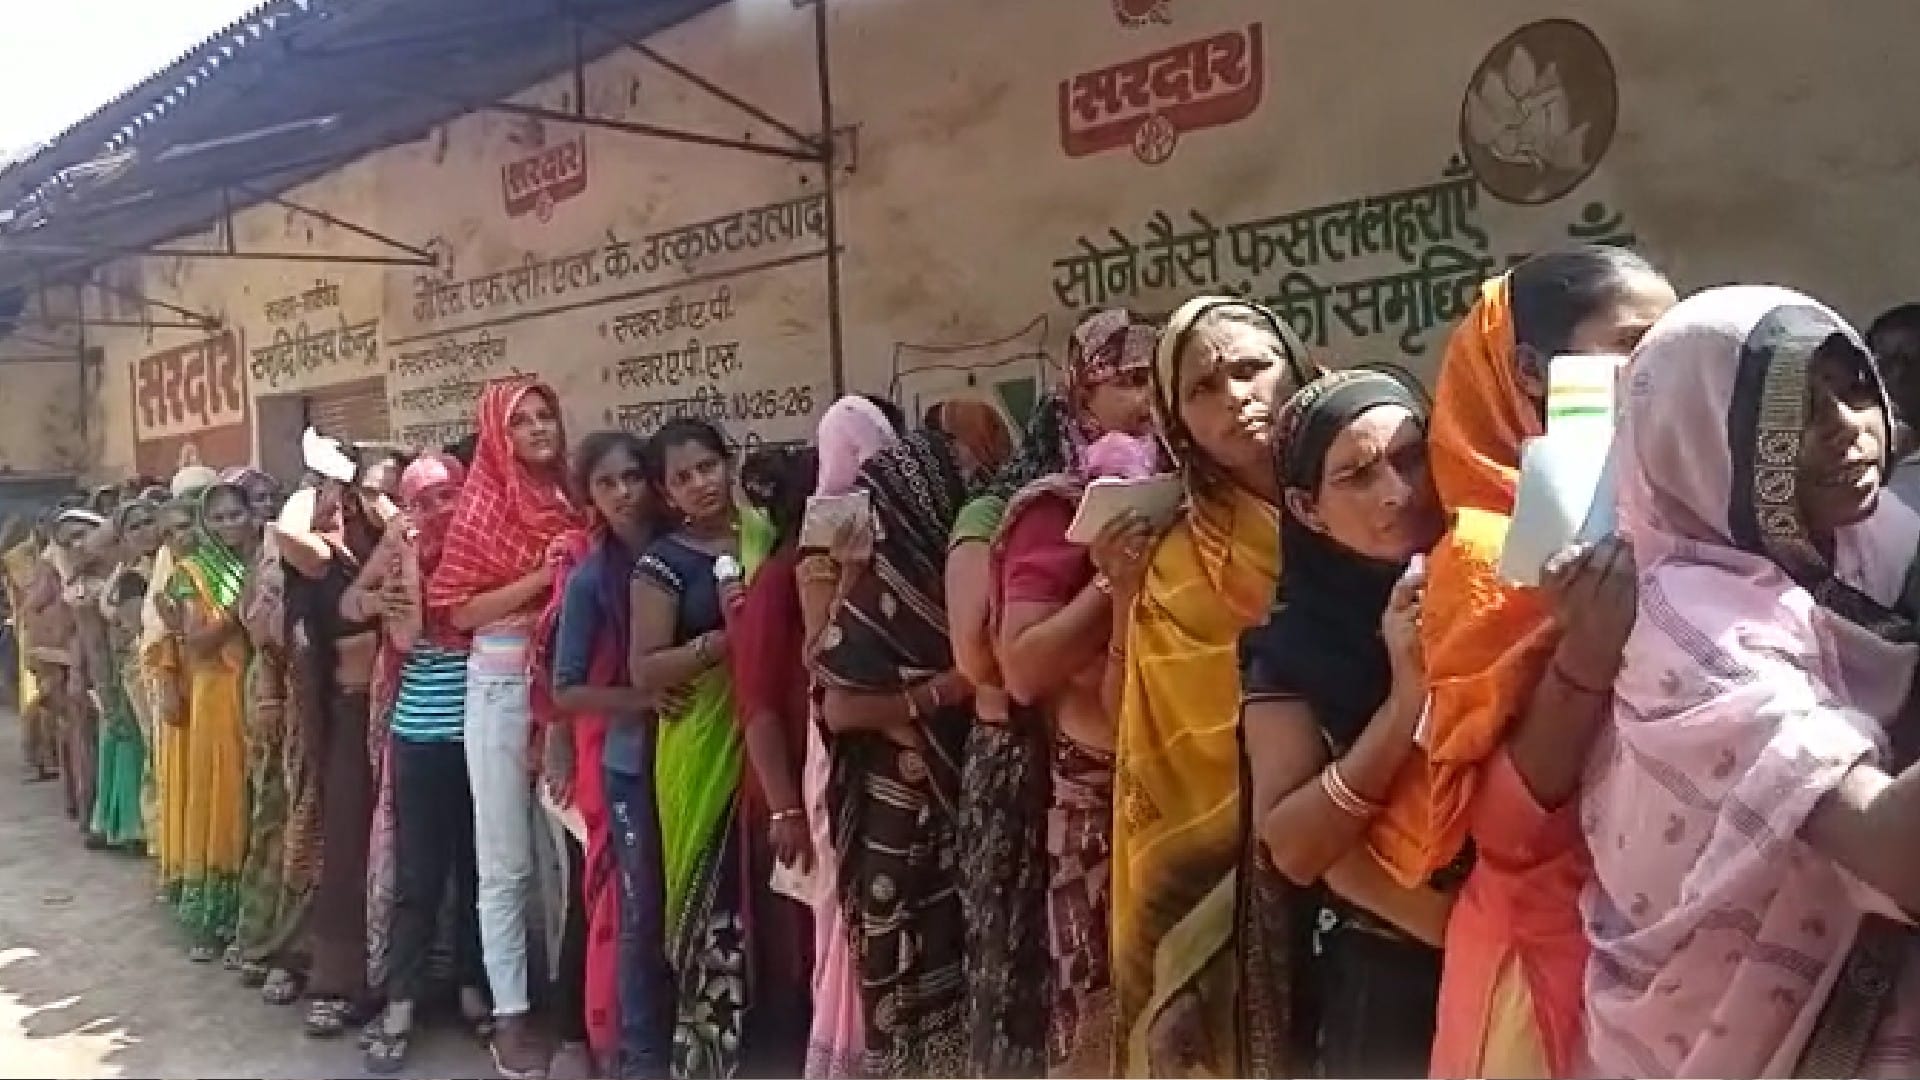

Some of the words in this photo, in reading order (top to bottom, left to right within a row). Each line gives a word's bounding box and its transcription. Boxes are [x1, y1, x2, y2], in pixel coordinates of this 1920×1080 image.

[1071, 32, 1247, 121] सरदार
[509, 139, 578, 195] सरदार
[1053, 227, 1139, 307] सोने
[1142, 209, 1220, 288] जैसे
[1227, 199, 1360, 274] फसल
[1266, 271, 1332, 347] की
[138, 330, 241, 428] सरदार
